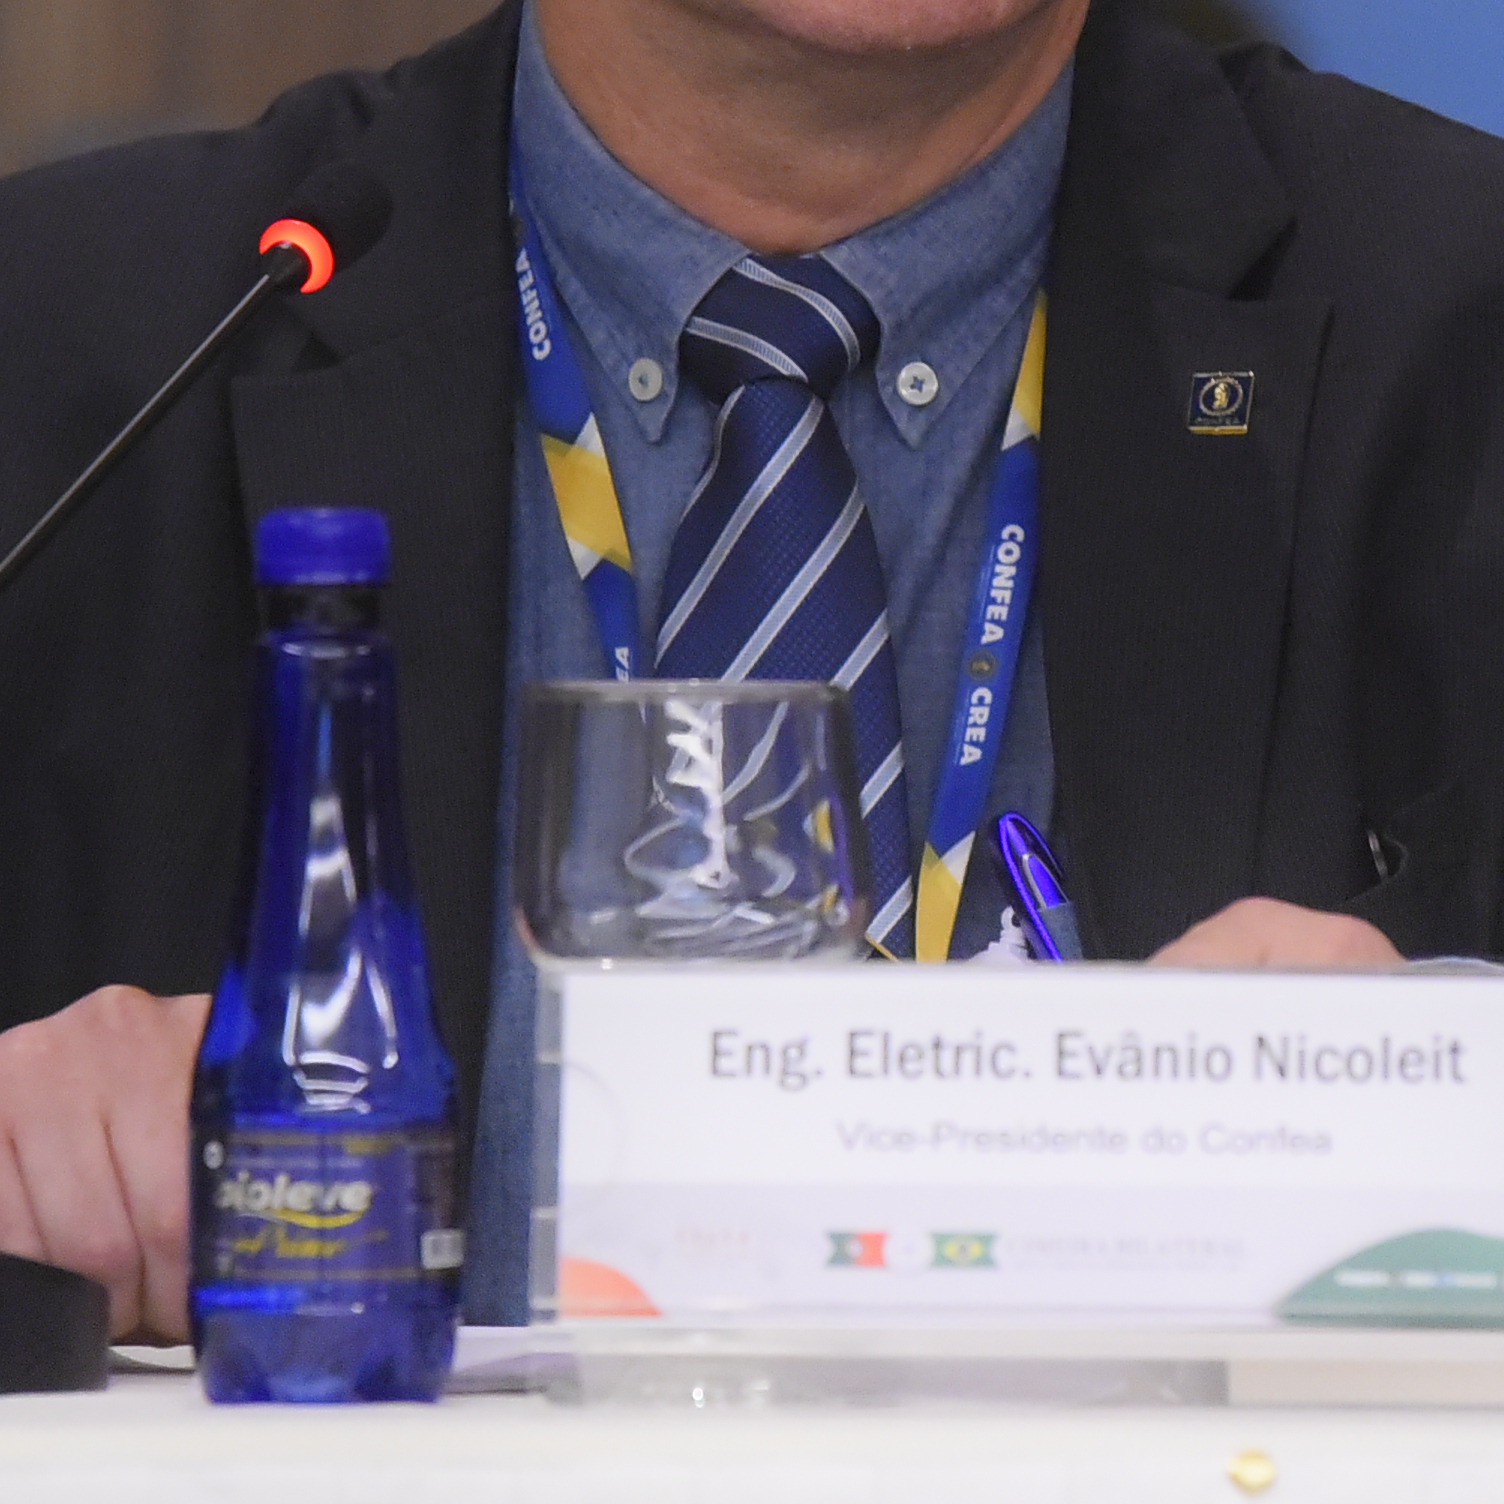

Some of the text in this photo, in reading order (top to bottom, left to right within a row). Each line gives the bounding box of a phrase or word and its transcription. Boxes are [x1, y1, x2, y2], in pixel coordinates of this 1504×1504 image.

[515, 248, 552, 361] CONFEA
[959, 523, 1026, 766] CONFEA CREA
[711, 1028, 1467, 1091] Eng. Eletric. Evânio Nicoleit
[1140, 1122, 1188, 1154] do
[1198, 1122, 1334, 1155] Confea
